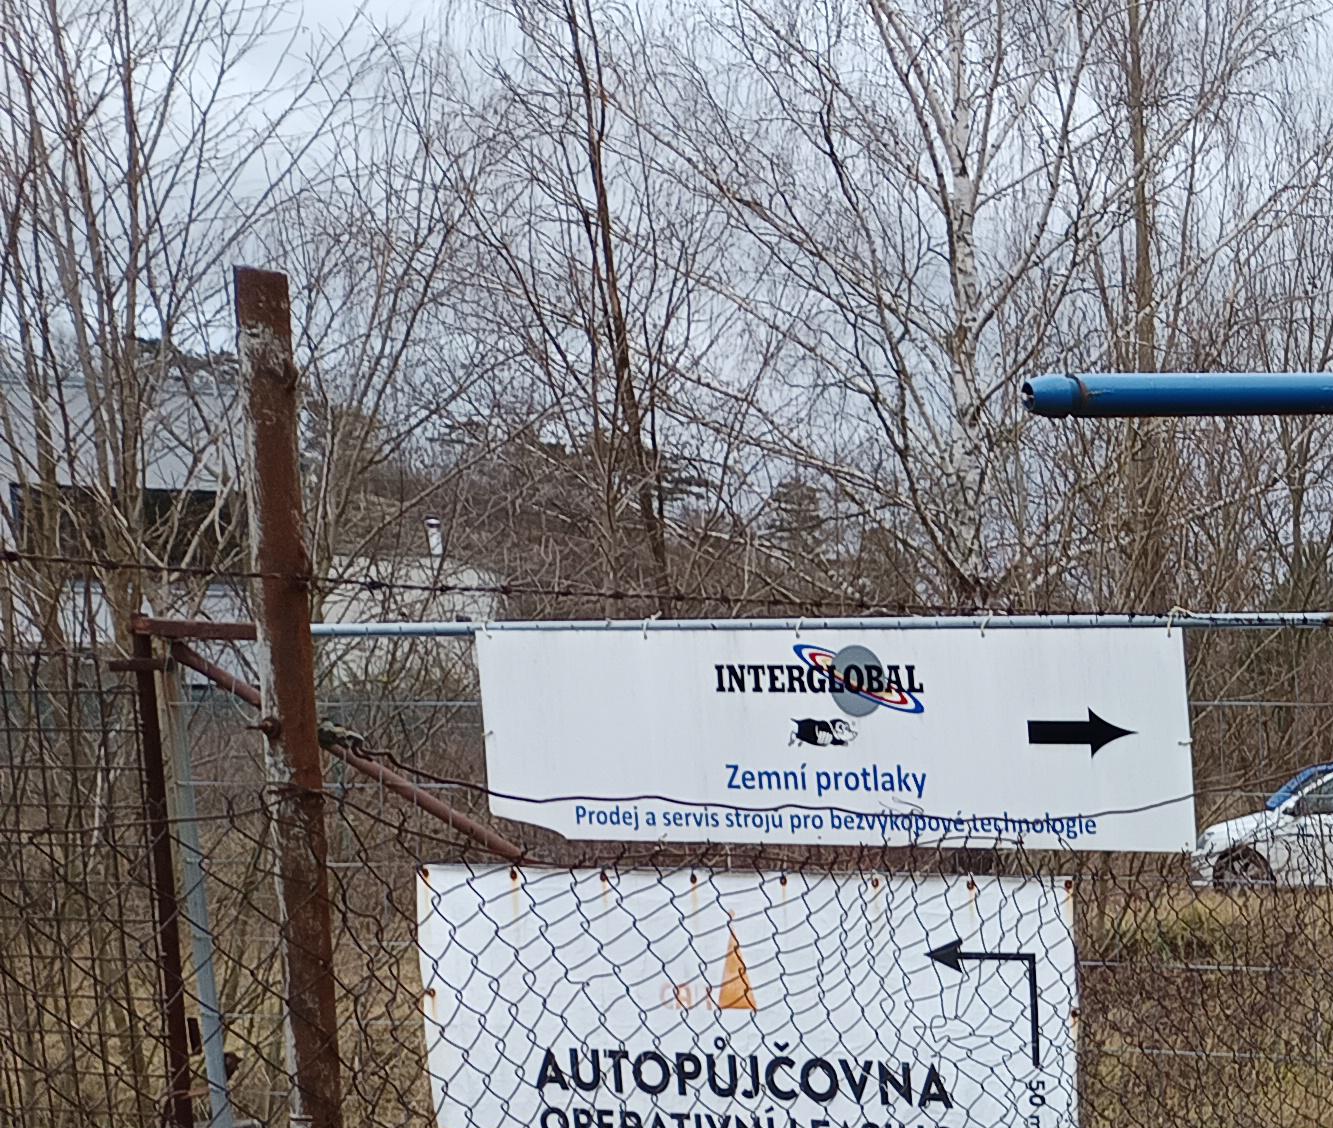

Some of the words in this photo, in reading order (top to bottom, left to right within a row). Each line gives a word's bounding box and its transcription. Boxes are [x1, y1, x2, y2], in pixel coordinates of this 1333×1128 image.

[714, 664, 924, 694] INTERGLOBAL
[725, 762, 807, 792] Zemní
[816, 763, 927, 799] protlaky
[575, 804, 639, 831] Prodej
[646, 810, 657, 827] a
[662, 805, 720, 828] servis
[790, 812, 824, 834] pro
[830, 808, 965, 838] bezvýkopové
[972, 812, 1097, 840] technologie
[536, 1036, 954, 1110] AUTOPŮJČOVNA
[1029, 1080, 1046, 1107] 50
